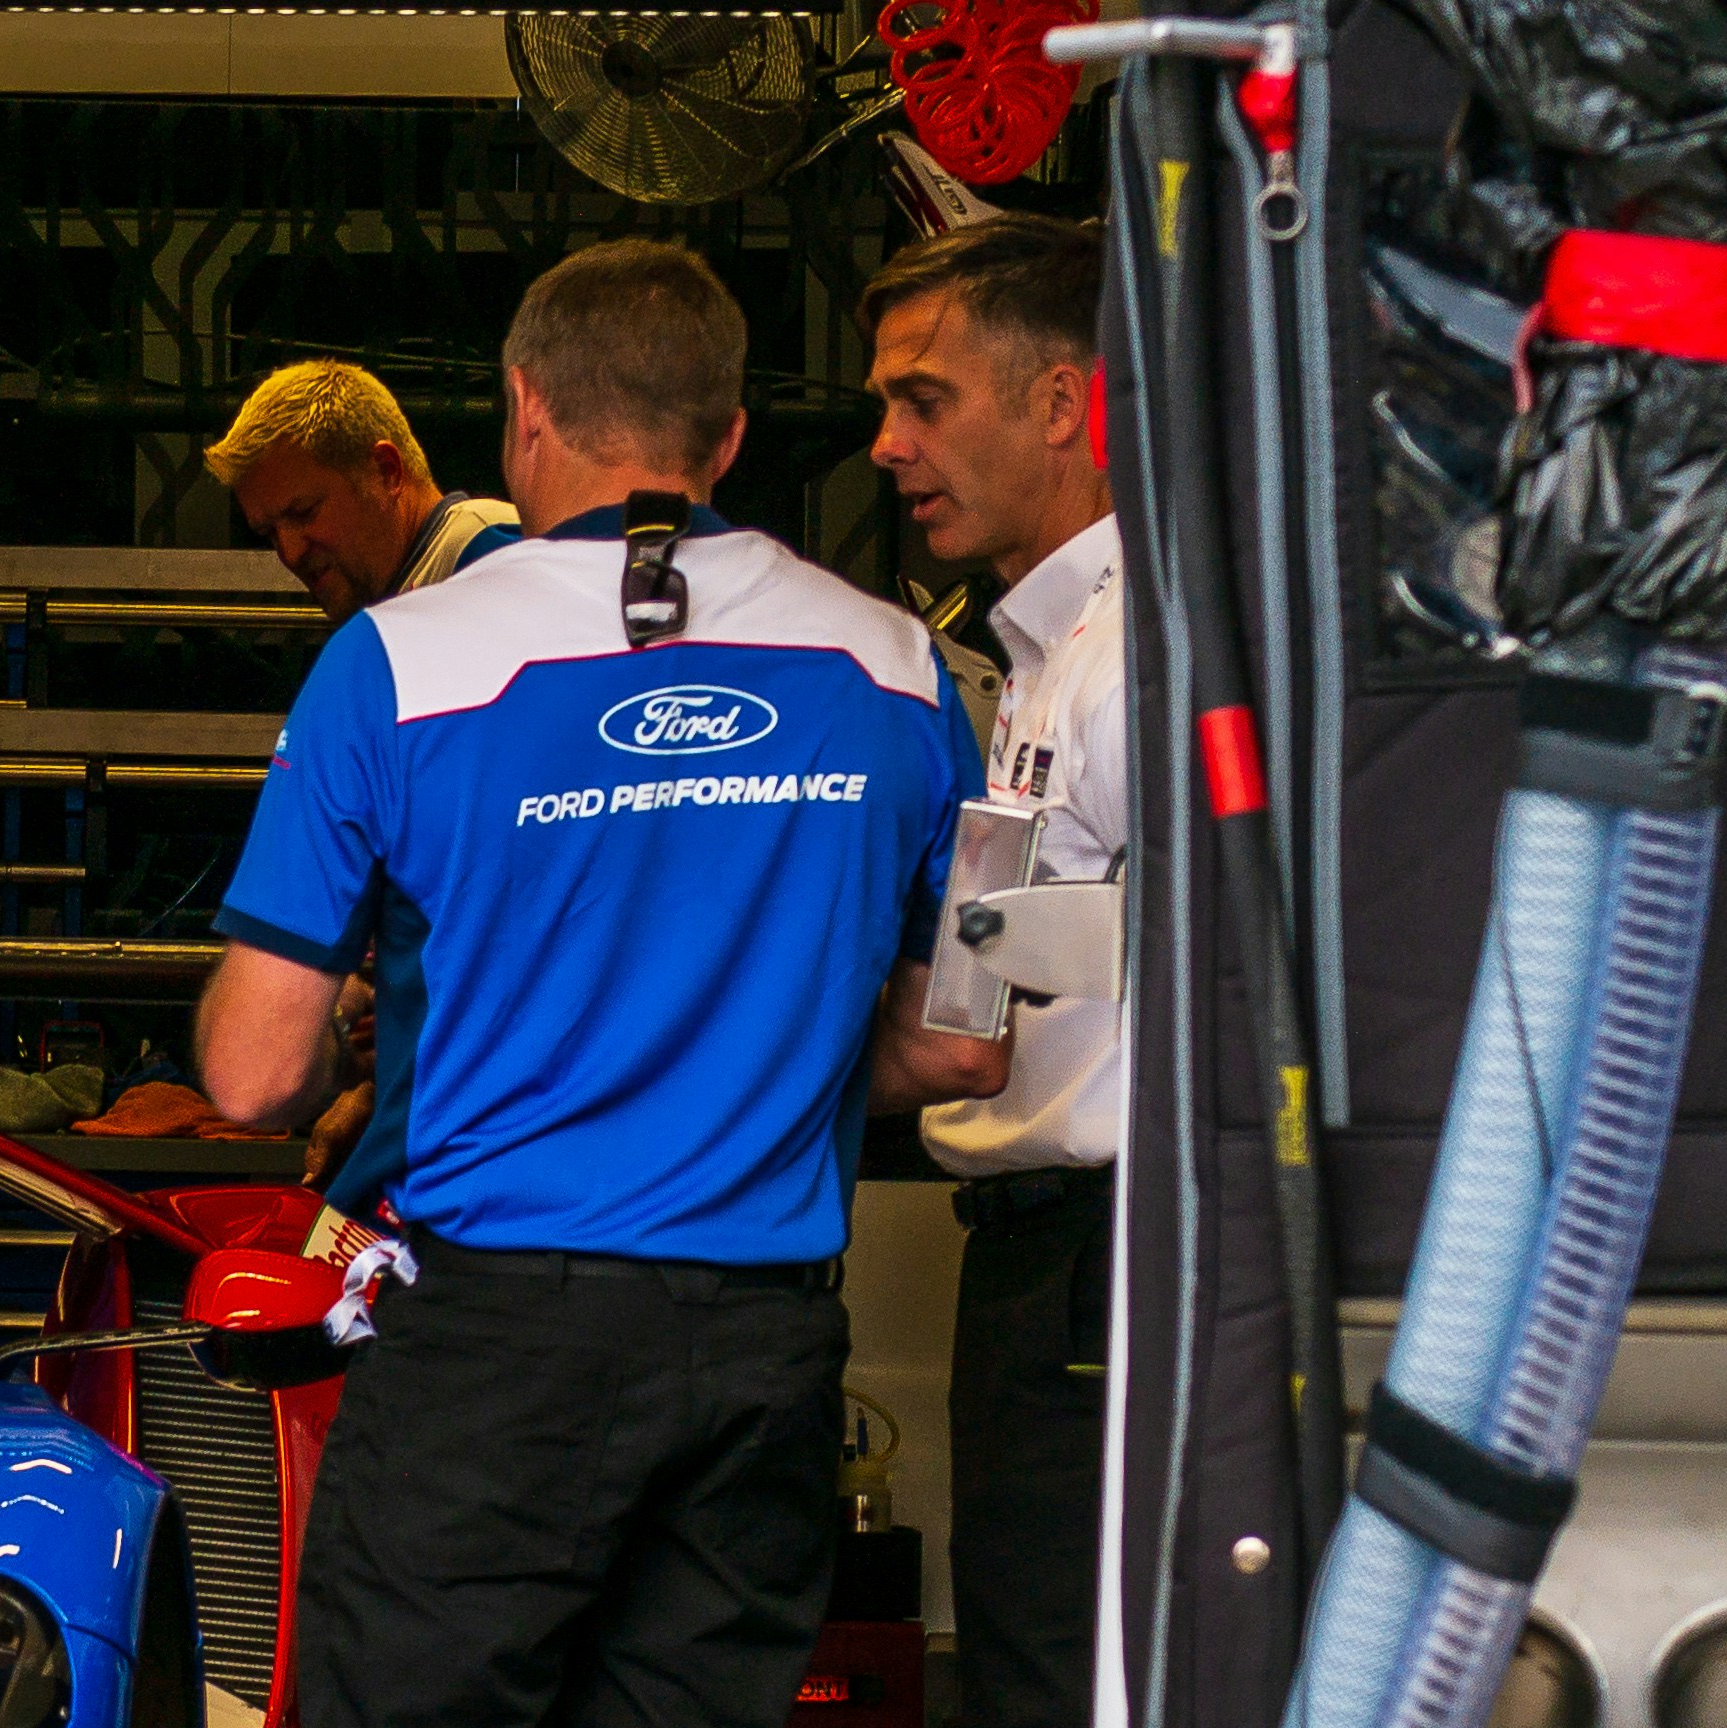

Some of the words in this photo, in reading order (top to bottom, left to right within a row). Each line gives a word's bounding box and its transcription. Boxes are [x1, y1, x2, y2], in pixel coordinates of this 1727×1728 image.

[634, 696, 739, 745] Ford
[517, 789, 605, 826] FORD
[609, 774, 867, 814] PERFORMANCE
